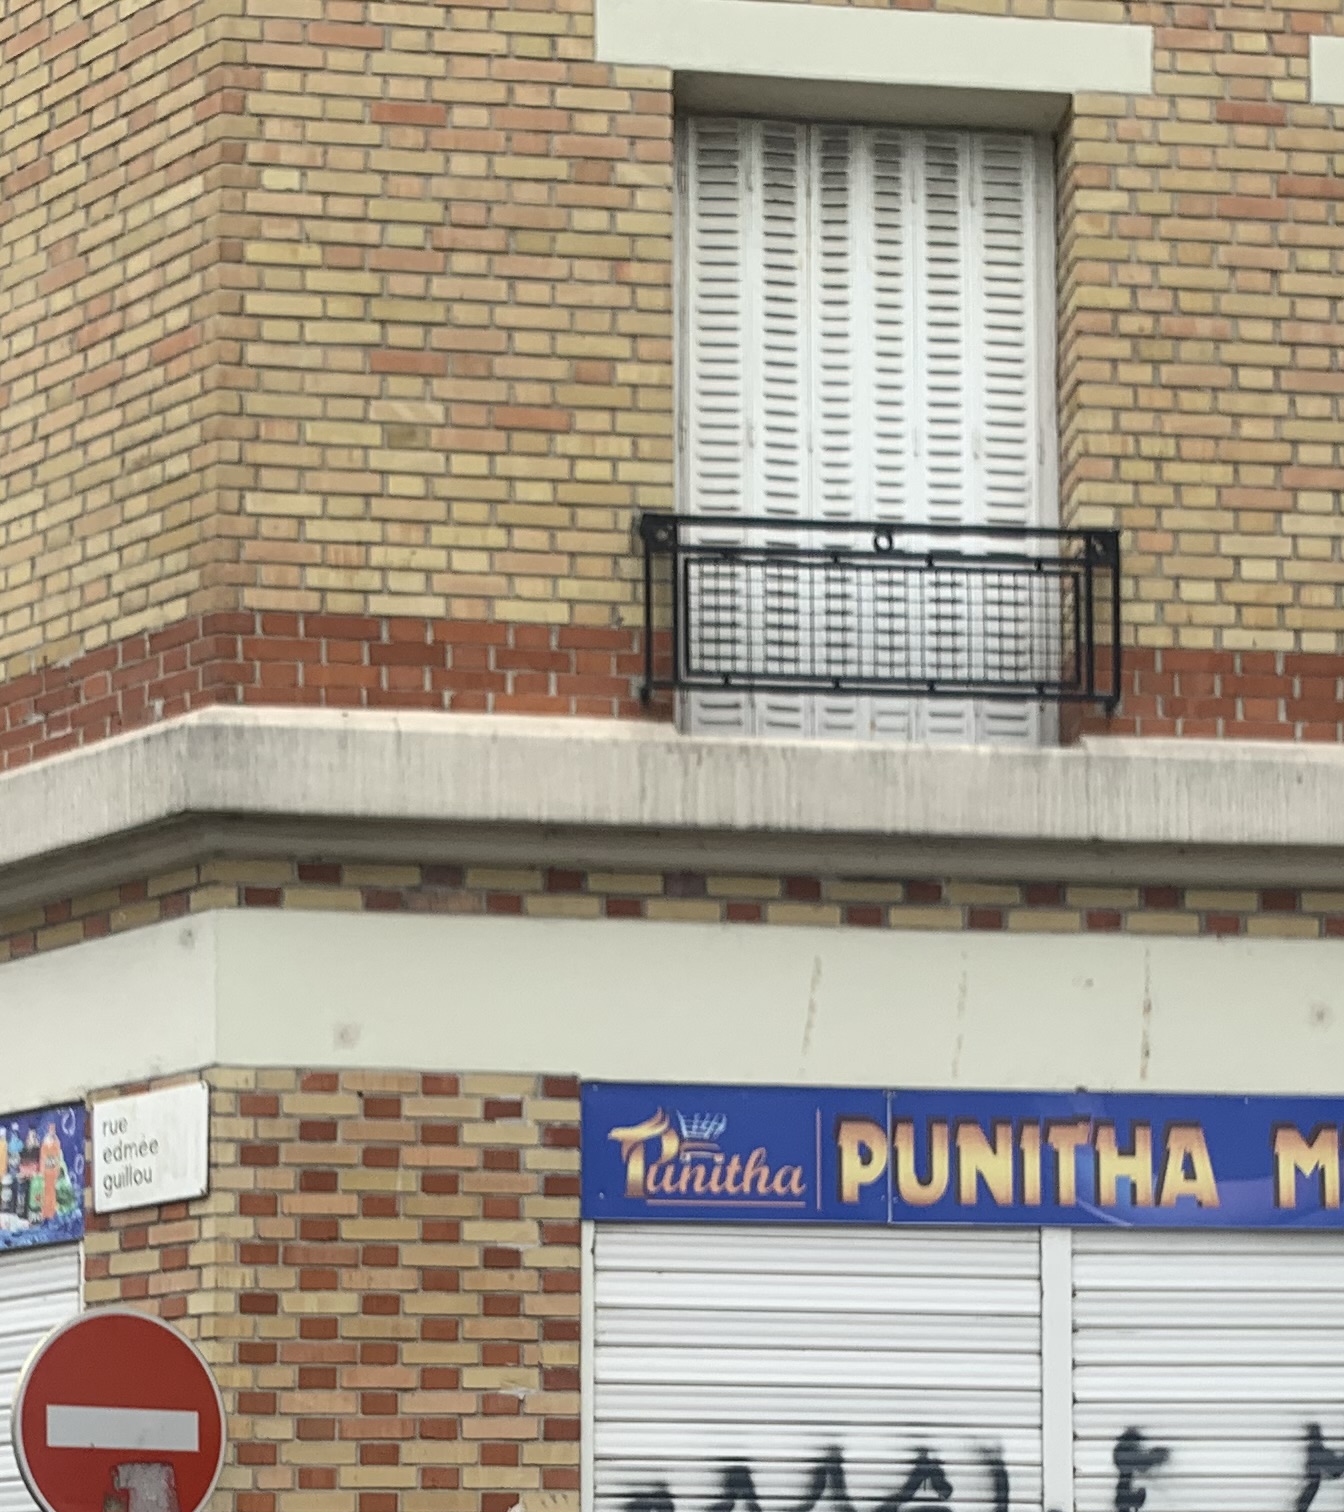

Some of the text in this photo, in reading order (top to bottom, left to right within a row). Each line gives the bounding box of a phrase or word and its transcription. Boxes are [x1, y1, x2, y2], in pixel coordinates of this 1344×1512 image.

[103, 1117, 128, 1137] rue
[608, 1107, 806, 1198] Punitha
[103, 1163, 153, 1199] guillou
[836, 1117, 1221, 1208] PUNITHA
